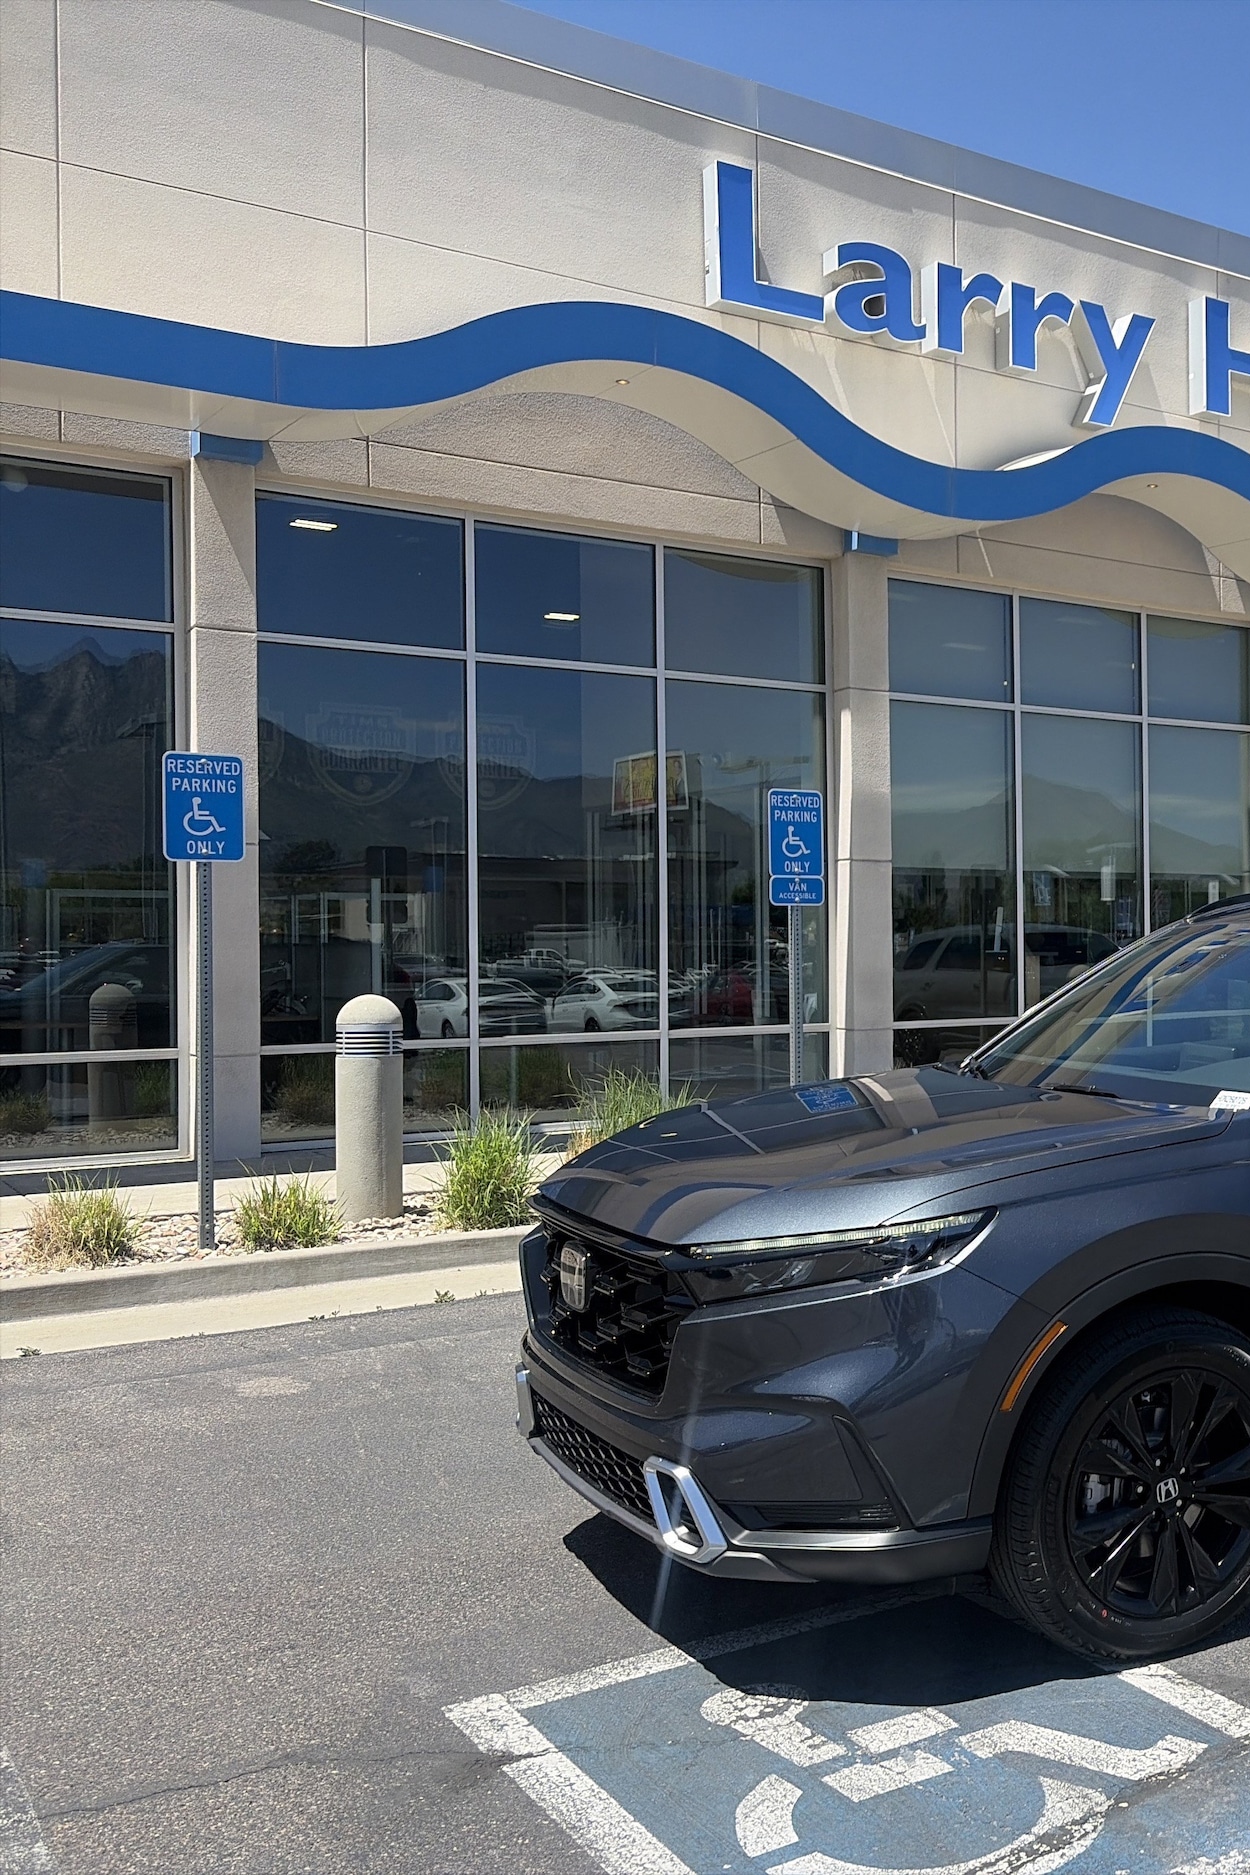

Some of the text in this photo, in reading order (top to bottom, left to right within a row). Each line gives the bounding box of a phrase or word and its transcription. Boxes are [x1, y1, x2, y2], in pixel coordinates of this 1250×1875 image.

[705, 160, 1156, 428] Larry
[167, 758, 240, 776] RESERVED
[172, 777, 237, 794] PARKING
[771, 794, 820, 809] RESERVED
[774, 810, 818, 823] PARKING
[187, 840, 226, 855] ONLY
[784, 861, 811, 874] ONLY
[788, 882, 807, 892] VAN
[779, 892, 817, 900] ACCESSIBLE
